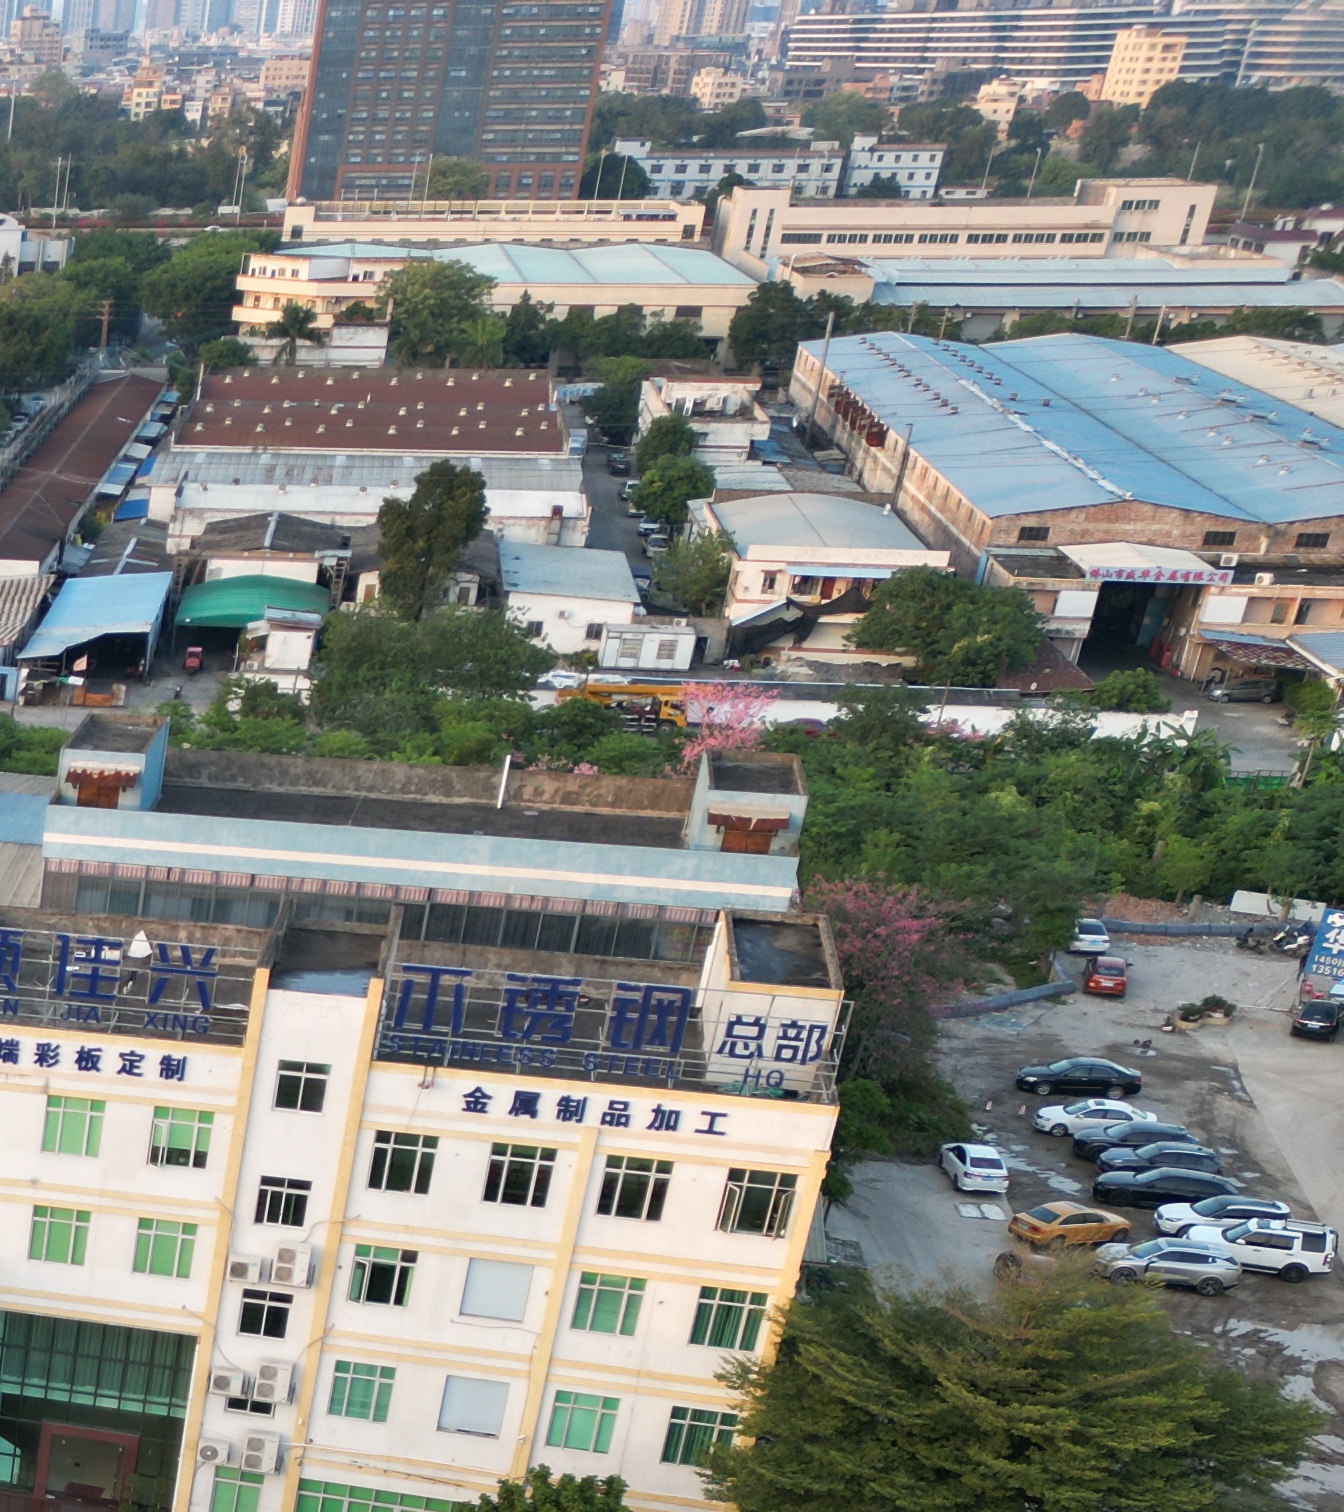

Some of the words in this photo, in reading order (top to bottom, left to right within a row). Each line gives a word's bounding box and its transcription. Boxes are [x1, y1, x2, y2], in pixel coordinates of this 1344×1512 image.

[59, 1003, 102, 1024] JIA
[142, 1011, 211, 1034] XING
[393, 965, 694, 1055] 不锈钢
[717, 1014, 828, 1066] 总部
[387, 1034, 558, 1068] STAINLESS
[582, 1051, 682, 1080] STEEL
[742, 1067, 785, 1088] HQ
[461, 1085, 730, 1137] 金属制品加工
